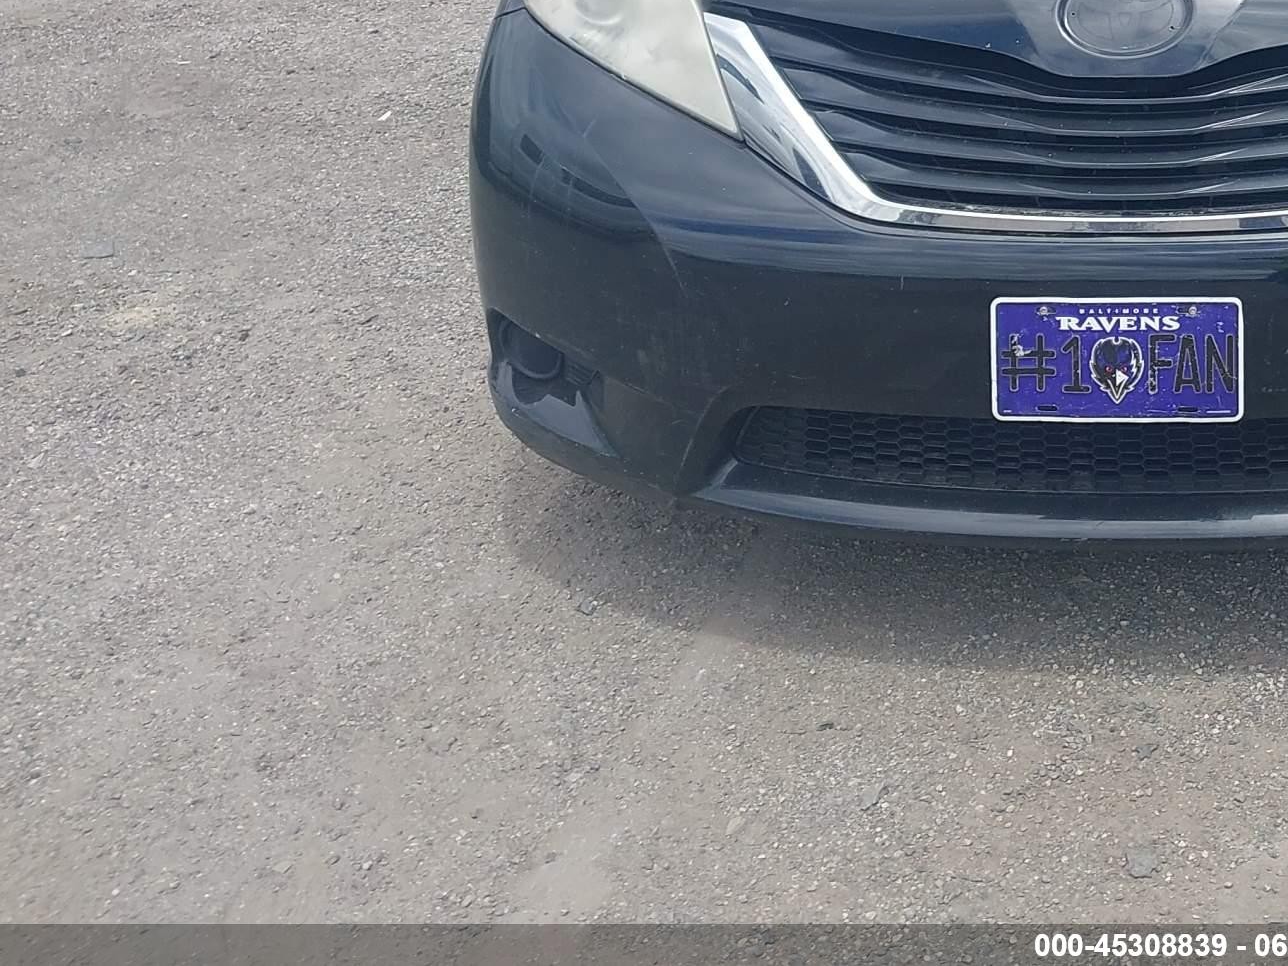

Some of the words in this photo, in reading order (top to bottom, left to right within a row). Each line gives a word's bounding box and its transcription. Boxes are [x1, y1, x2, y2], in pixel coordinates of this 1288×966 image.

[1056, 316, 1181, 333] RAVENS
[1001, 333, 1092, 394] #1
[1147, 333, 1237, 394] FAN
